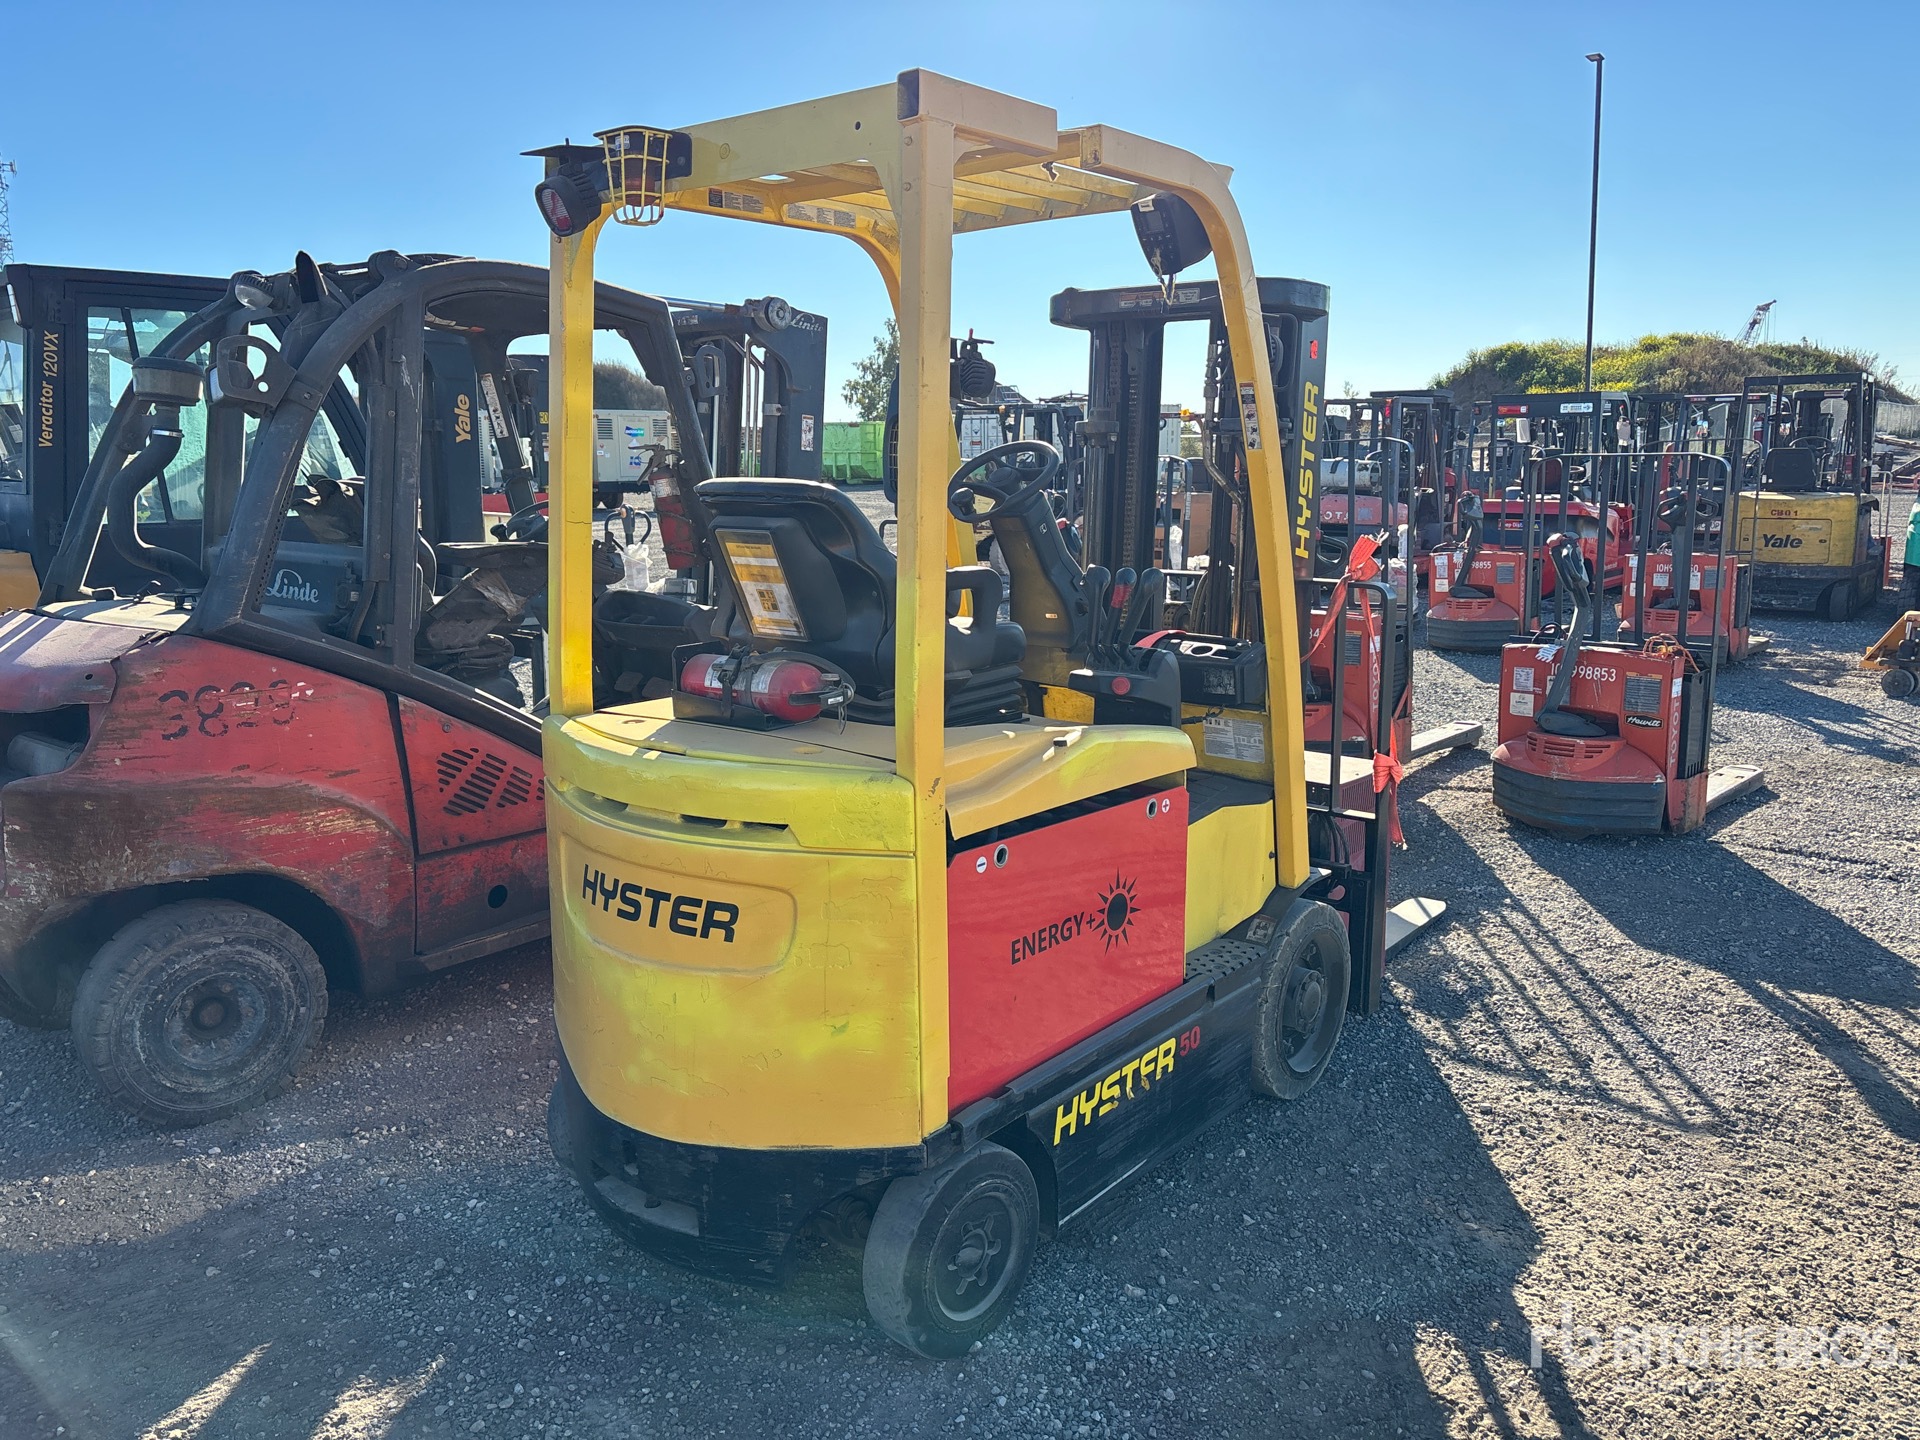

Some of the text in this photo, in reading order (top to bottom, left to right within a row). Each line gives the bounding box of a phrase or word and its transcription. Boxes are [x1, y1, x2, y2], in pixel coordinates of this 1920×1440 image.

[38, 331, 60, 448] Veracitor 120VX
[455, 394, 471, 444] Yale
[1295, 381, 1319, 560] HYSTER
[1762, 533, 1803, 548] Yale
[265, 568, 319, 604] Linde
[1627, 715, 1661, 727] Hewitt
[582, 864, 739, 944] HYSTER
[1053, 1026, 1201, 1147] HYSTER 50
